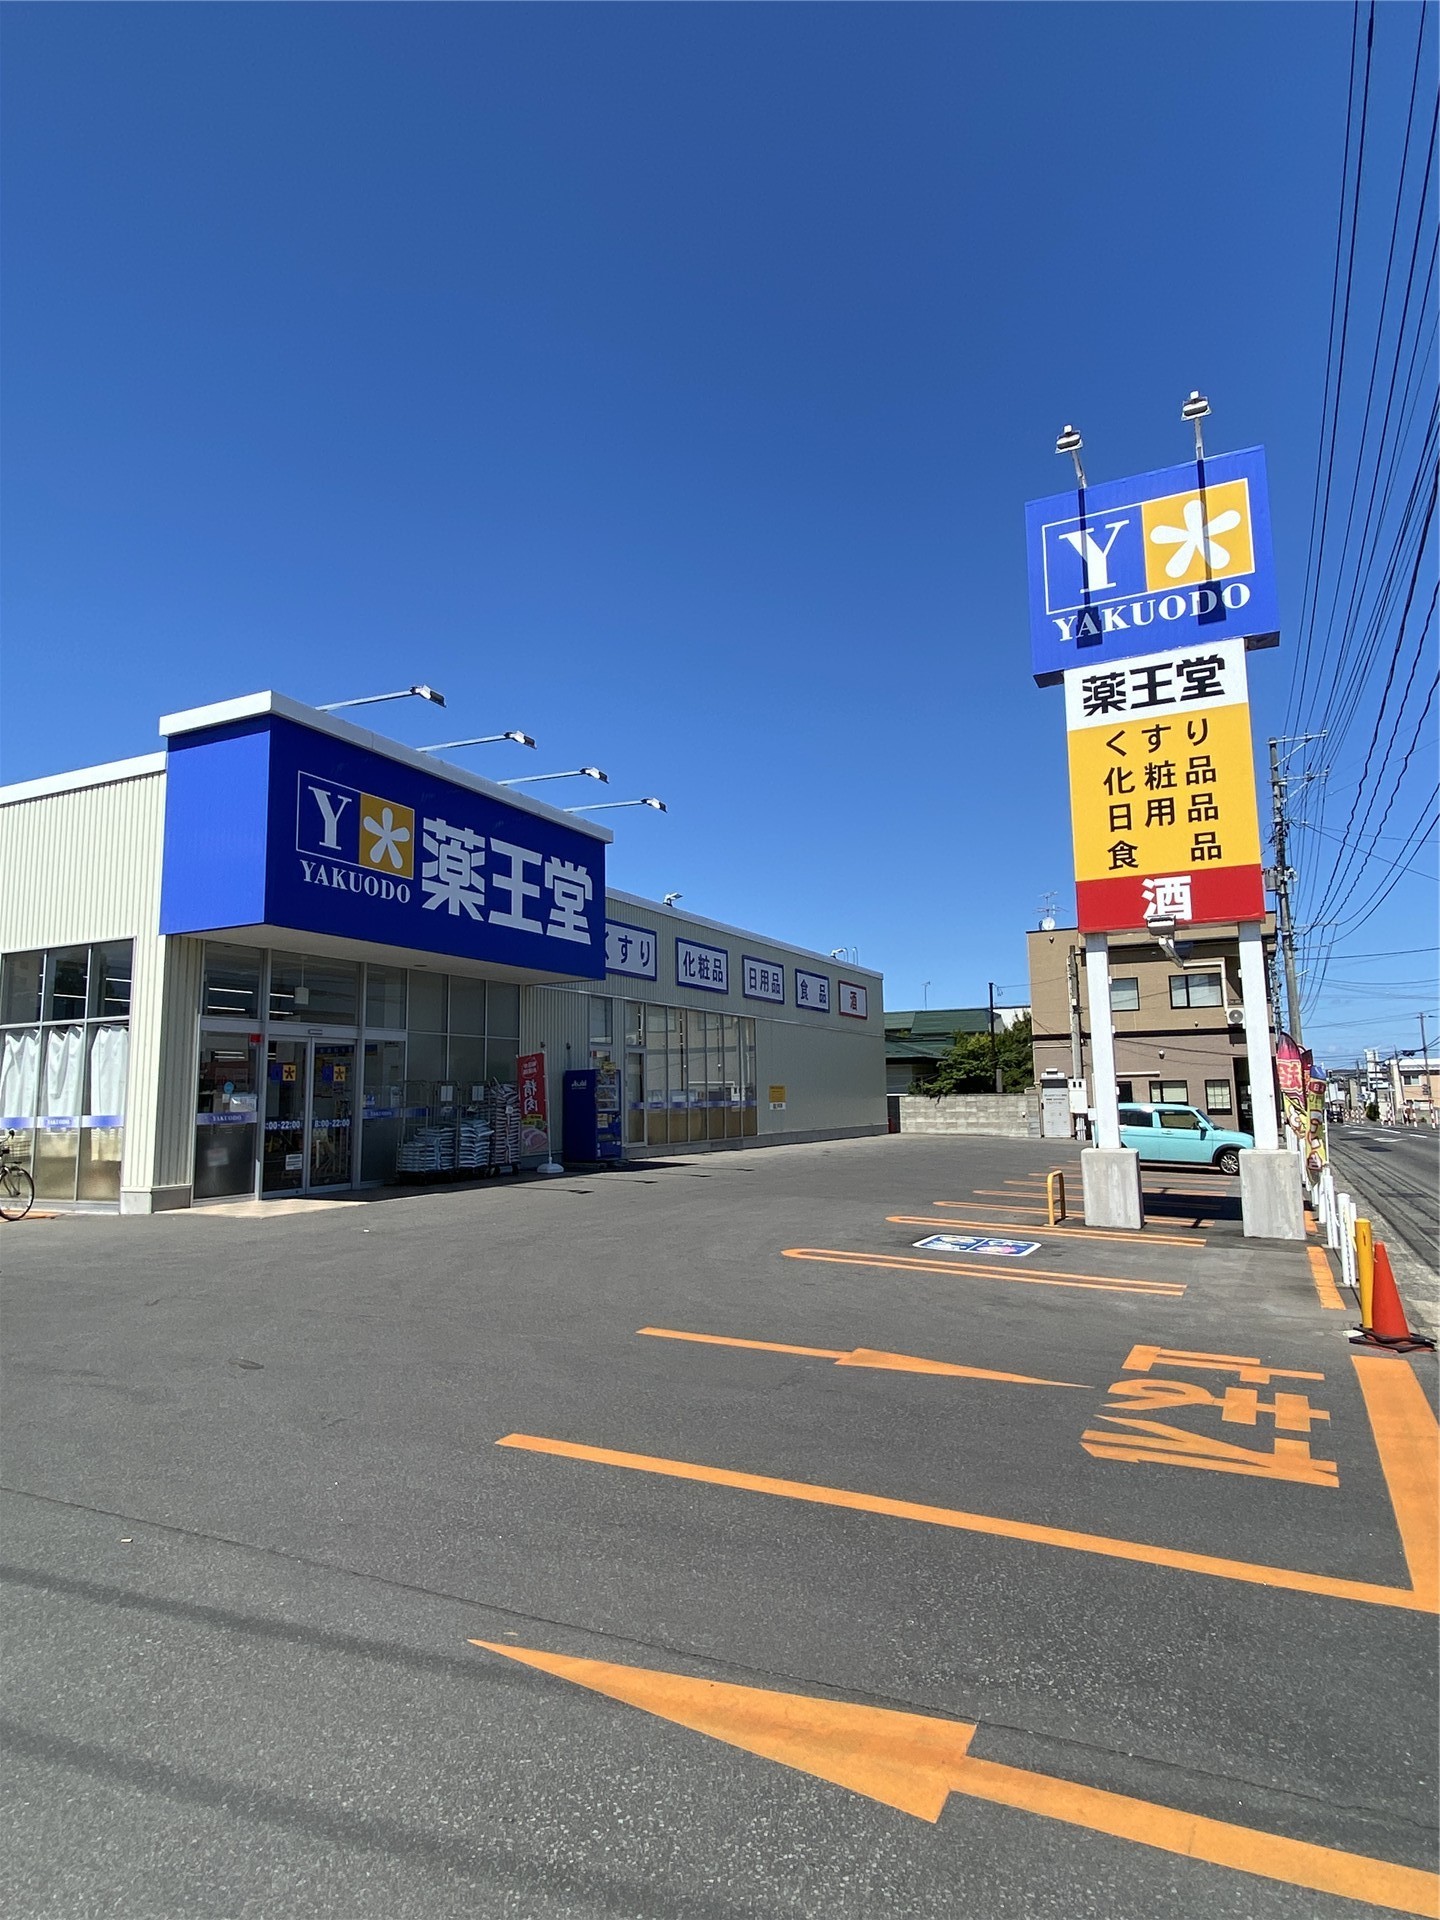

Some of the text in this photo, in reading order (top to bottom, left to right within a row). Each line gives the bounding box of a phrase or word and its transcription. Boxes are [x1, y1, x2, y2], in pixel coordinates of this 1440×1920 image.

[1058, 519, 1130, 594] Y
[1052, 583, 1251, 642] YAKUODO
[1082, 653, 1226, 718] 薬王堂
[1105, 718, 1209, 757] くすり
[1103, 754, 1218, 796] 化粧品
[307, 785, 352, 851] Y
[1109, 792, 1220, 833] 日用品
[299, 859, 411, 904] YAKUODO
[421, 817, 594, 945] 薬王堂
[1141, 875, 1193, 922] 酒
[682, 950, 724, 983] 化粧品
[749, 966, 781, 995] 日用品
